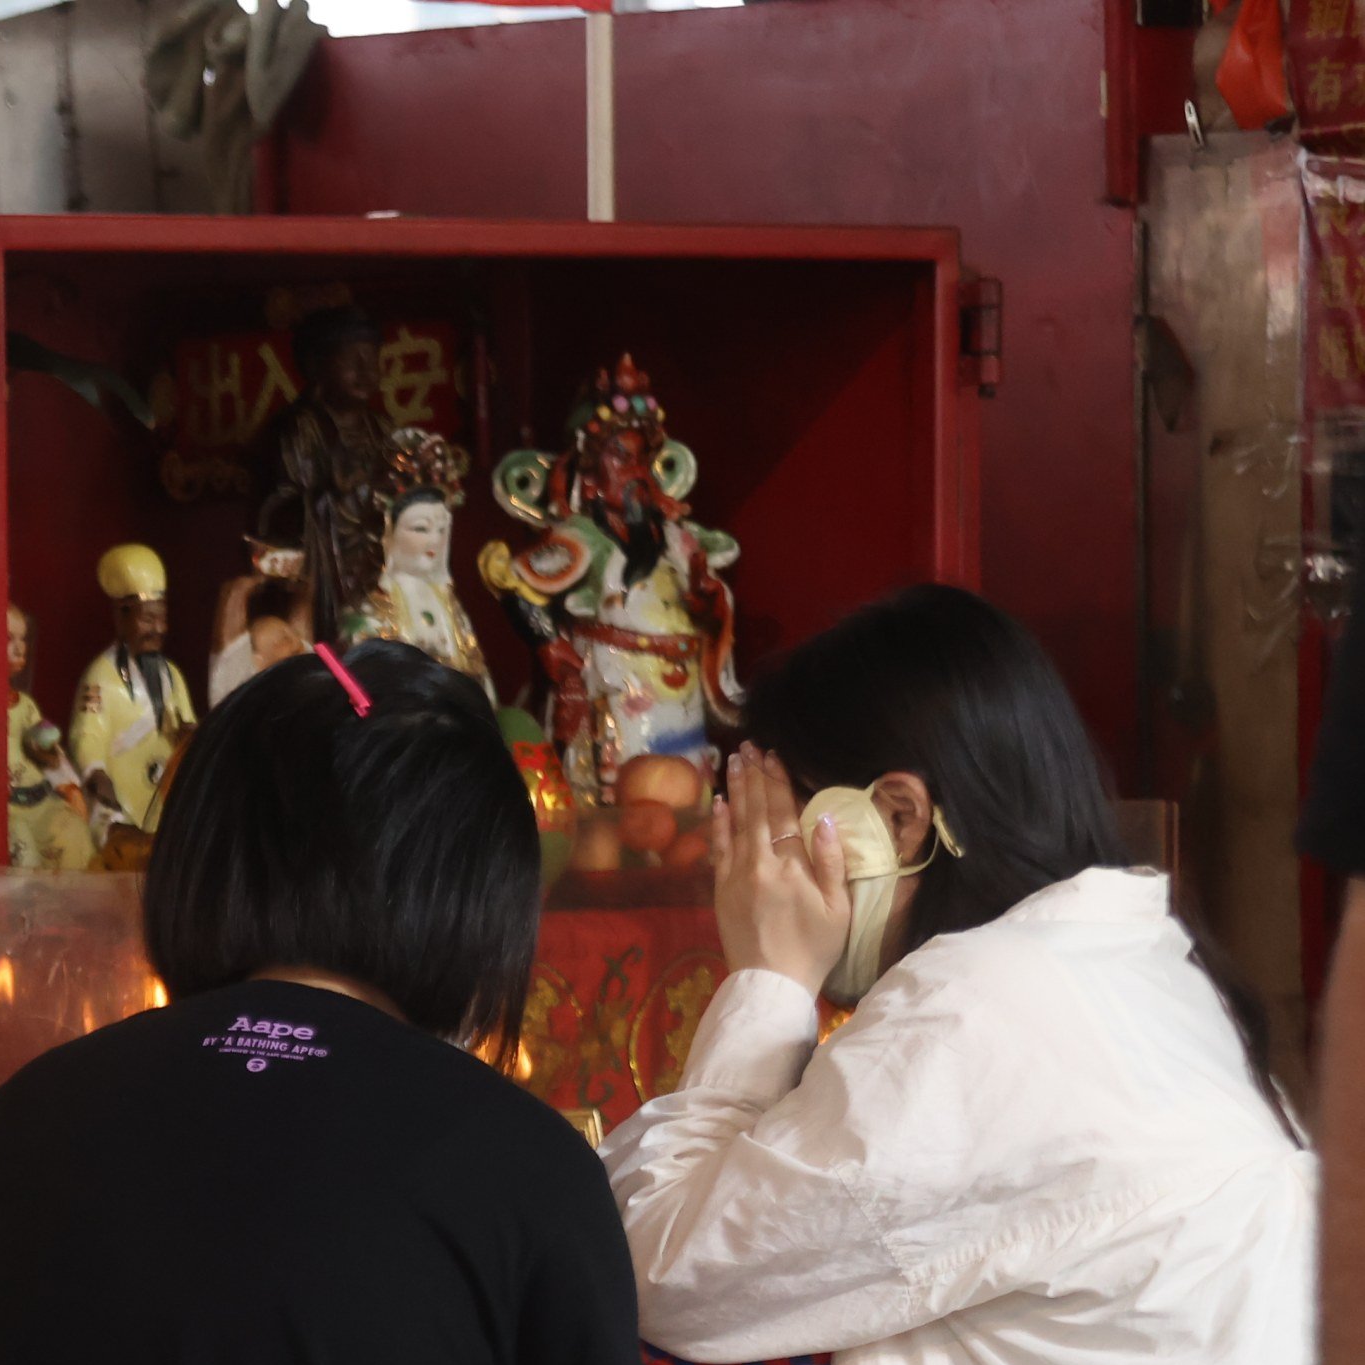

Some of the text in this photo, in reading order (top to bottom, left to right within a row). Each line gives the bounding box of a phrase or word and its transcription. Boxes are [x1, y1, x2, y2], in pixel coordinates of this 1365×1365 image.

[184, 326, 448, 444] 出入安
[228, 1017, 314, 1040] Aape
[202, 1038, 218, 1046] BY
[237, 1037, 288, 1051] BATHING
